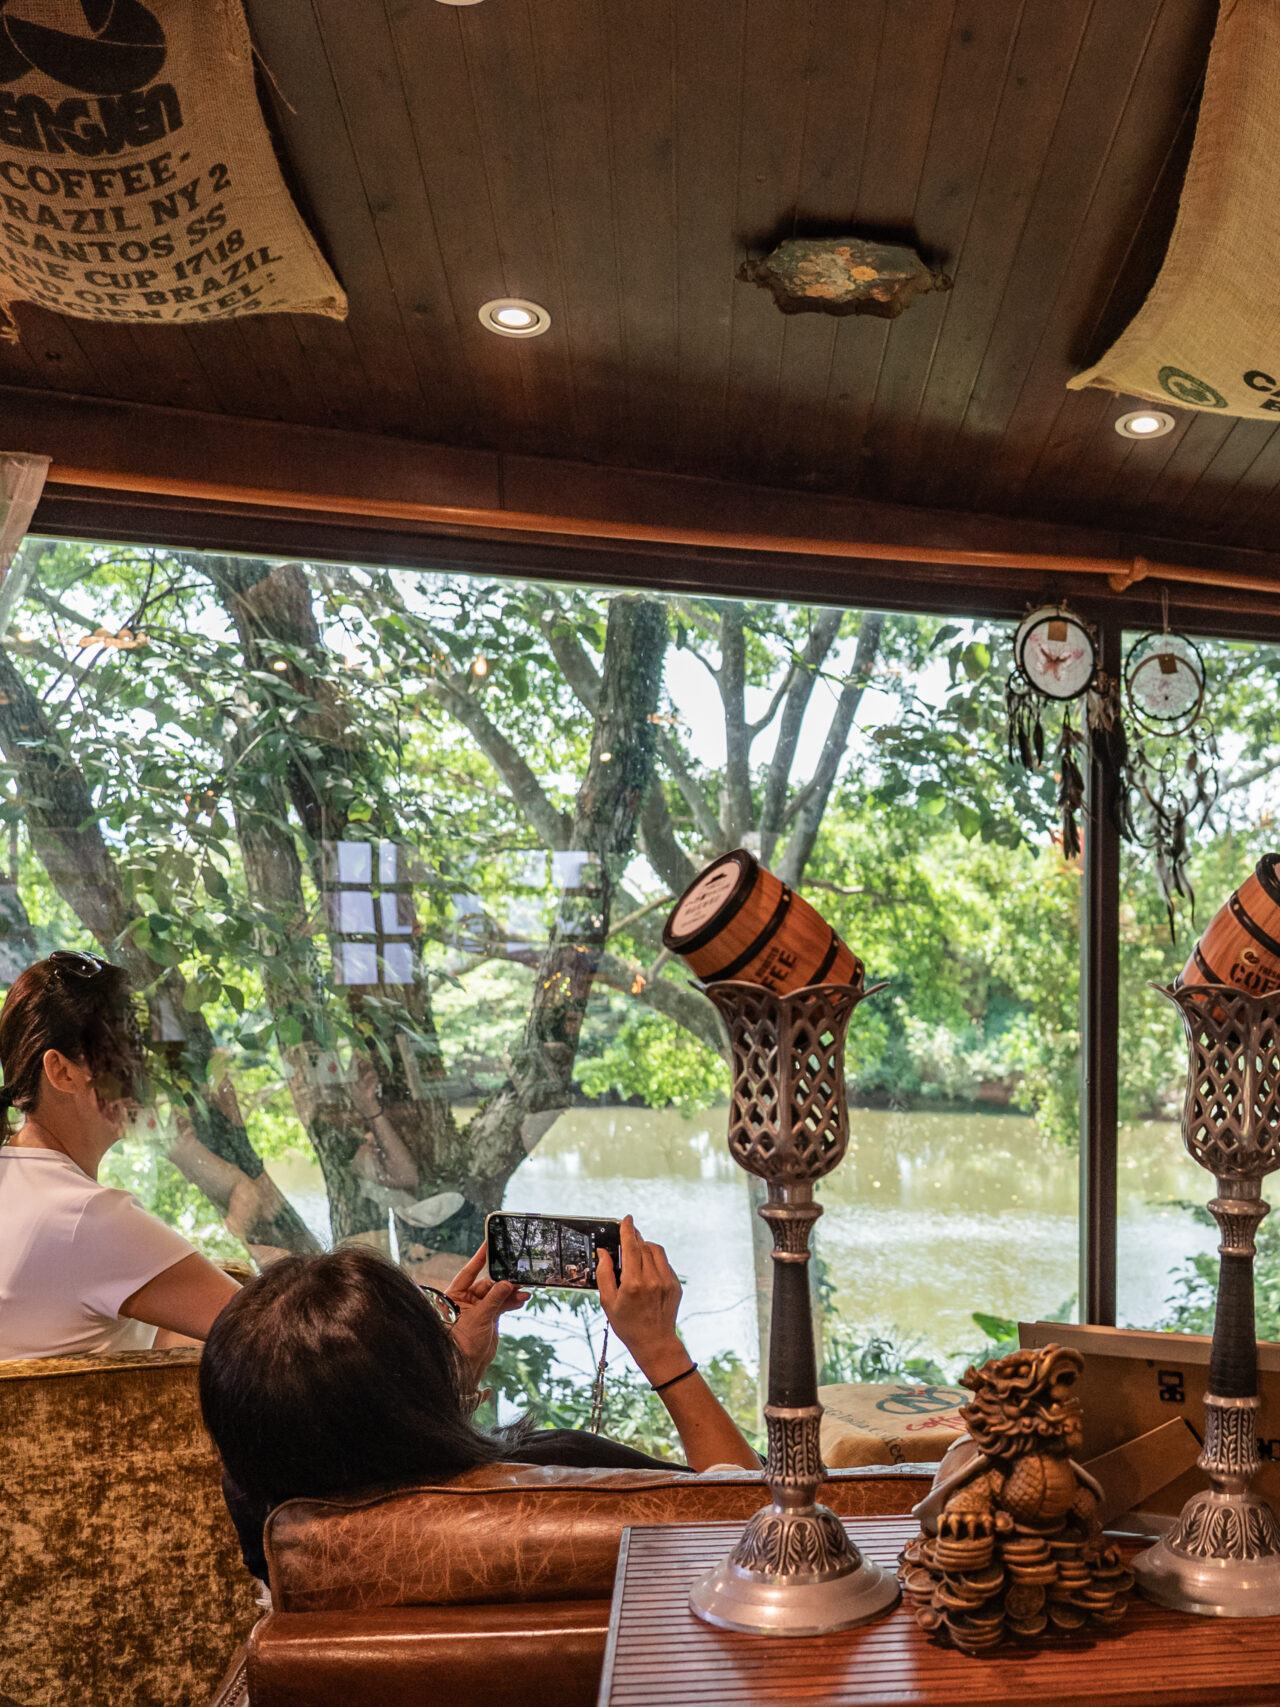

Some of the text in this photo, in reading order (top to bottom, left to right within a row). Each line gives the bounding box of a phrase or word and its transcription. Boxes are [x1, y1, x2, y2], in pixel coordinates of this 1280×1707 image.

[149, 177, 201, 228] NY
[208, 163, 231, 193] 2
[2, 202, 227, 263] SANTOS SS
[75, 289, 130, 306] OF
[141, 246, 284, 306] BRAZIL
[84, 270, 159, 290] CUP
